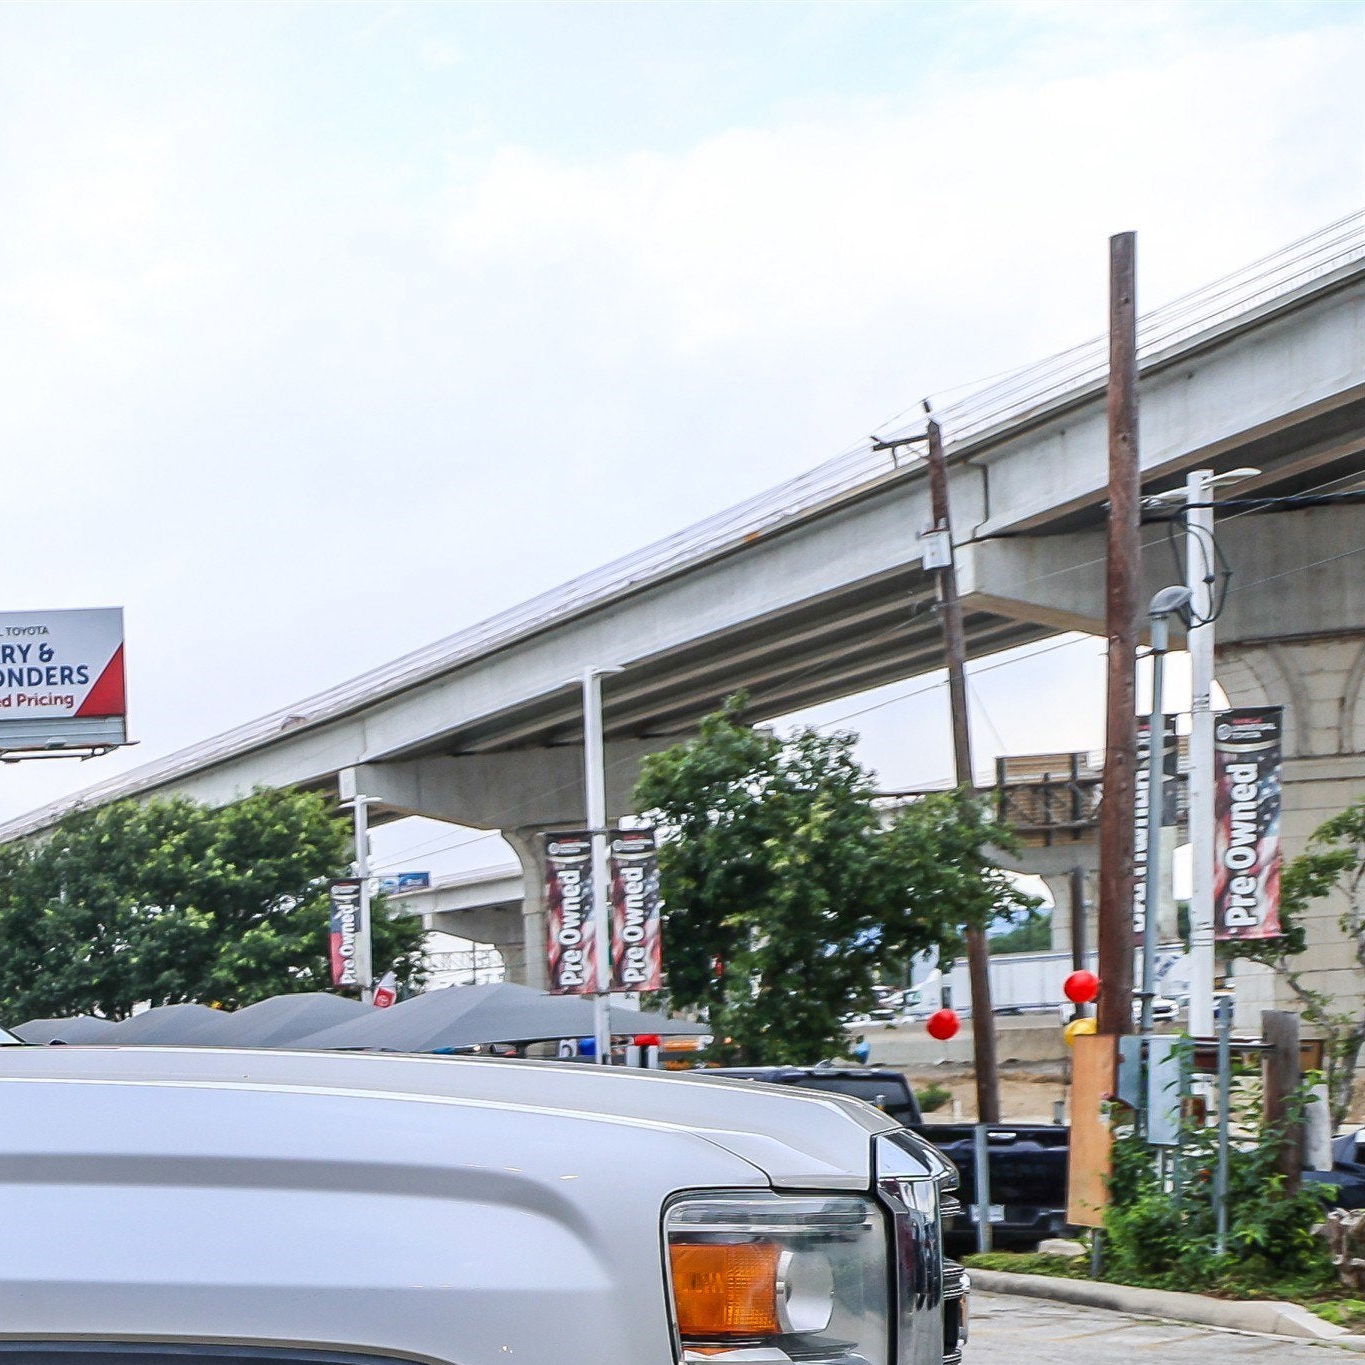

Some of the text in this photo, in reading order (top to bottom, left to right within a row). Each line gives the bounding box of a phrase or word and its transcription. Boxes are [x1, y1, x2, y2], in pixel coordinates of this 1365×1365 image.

[6, 625, 50, 637] TOYOTA
[38, 643, 55, 663] &
[16, 692, 74, 709] Pricing
[1225, 762, 1259, 870] Owned
[557, 870, 583, 945] Owned
[620, 867, 645, 942] Owned
[1226, 877, 1259, 927] Pre
